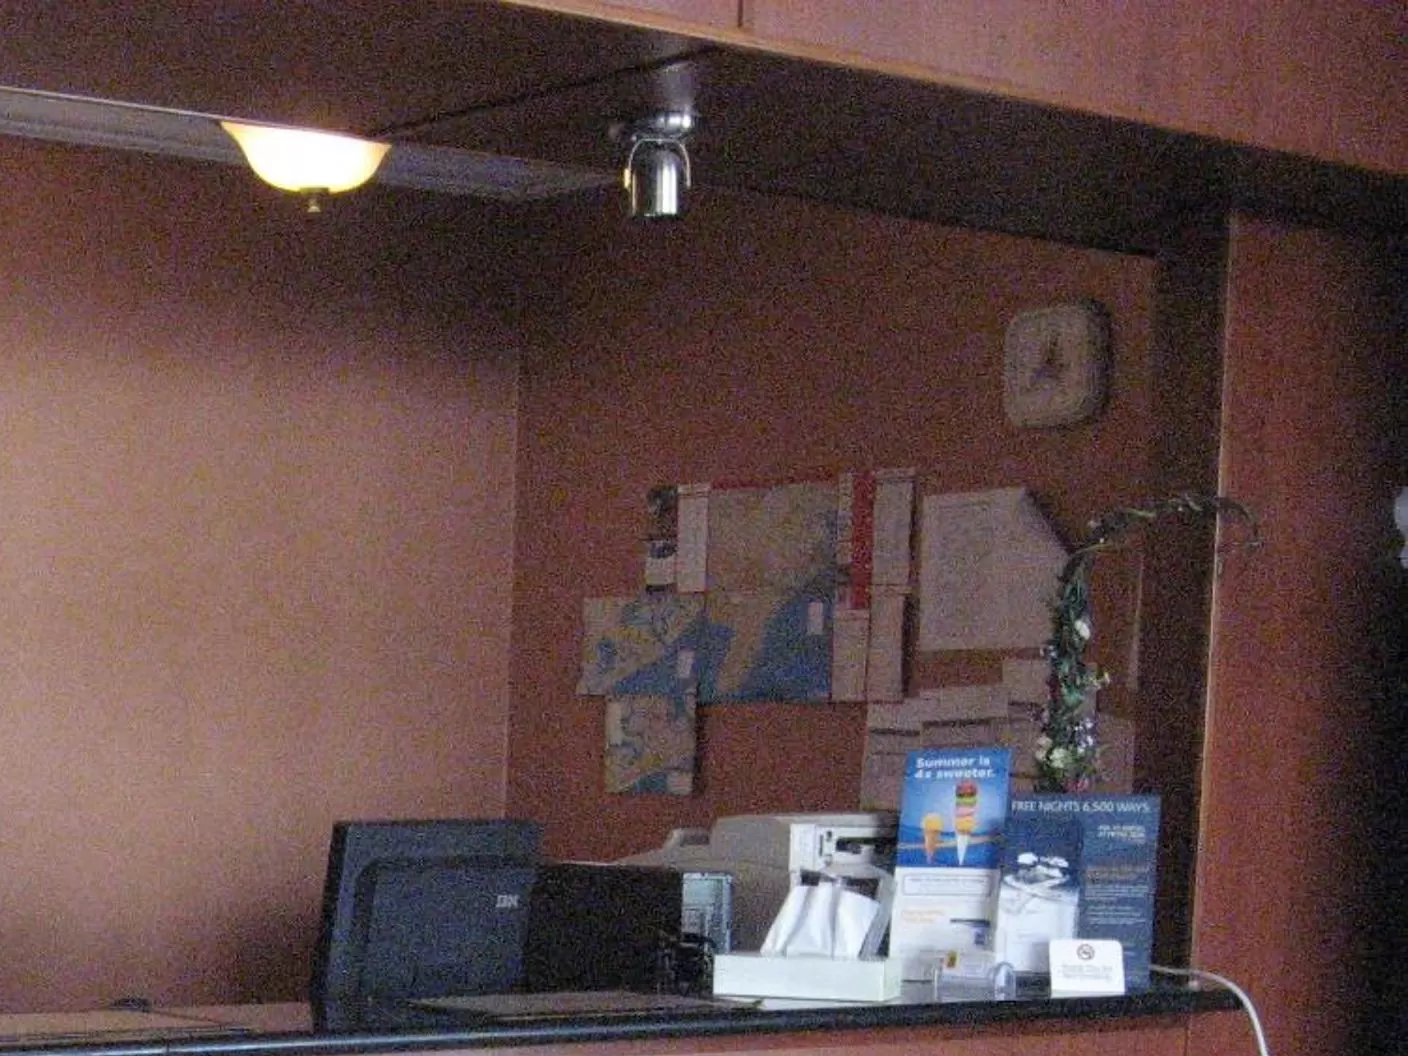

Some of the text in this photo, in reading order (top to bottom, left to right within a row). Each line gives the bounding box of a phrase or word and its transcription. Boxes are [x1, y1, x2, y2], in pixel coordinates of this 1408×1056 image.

[916, 755, 991, 769] Summer is
[1011, 800, 1036, 812] FREE
[1038, 800, 1080, 812] NIGHTS
